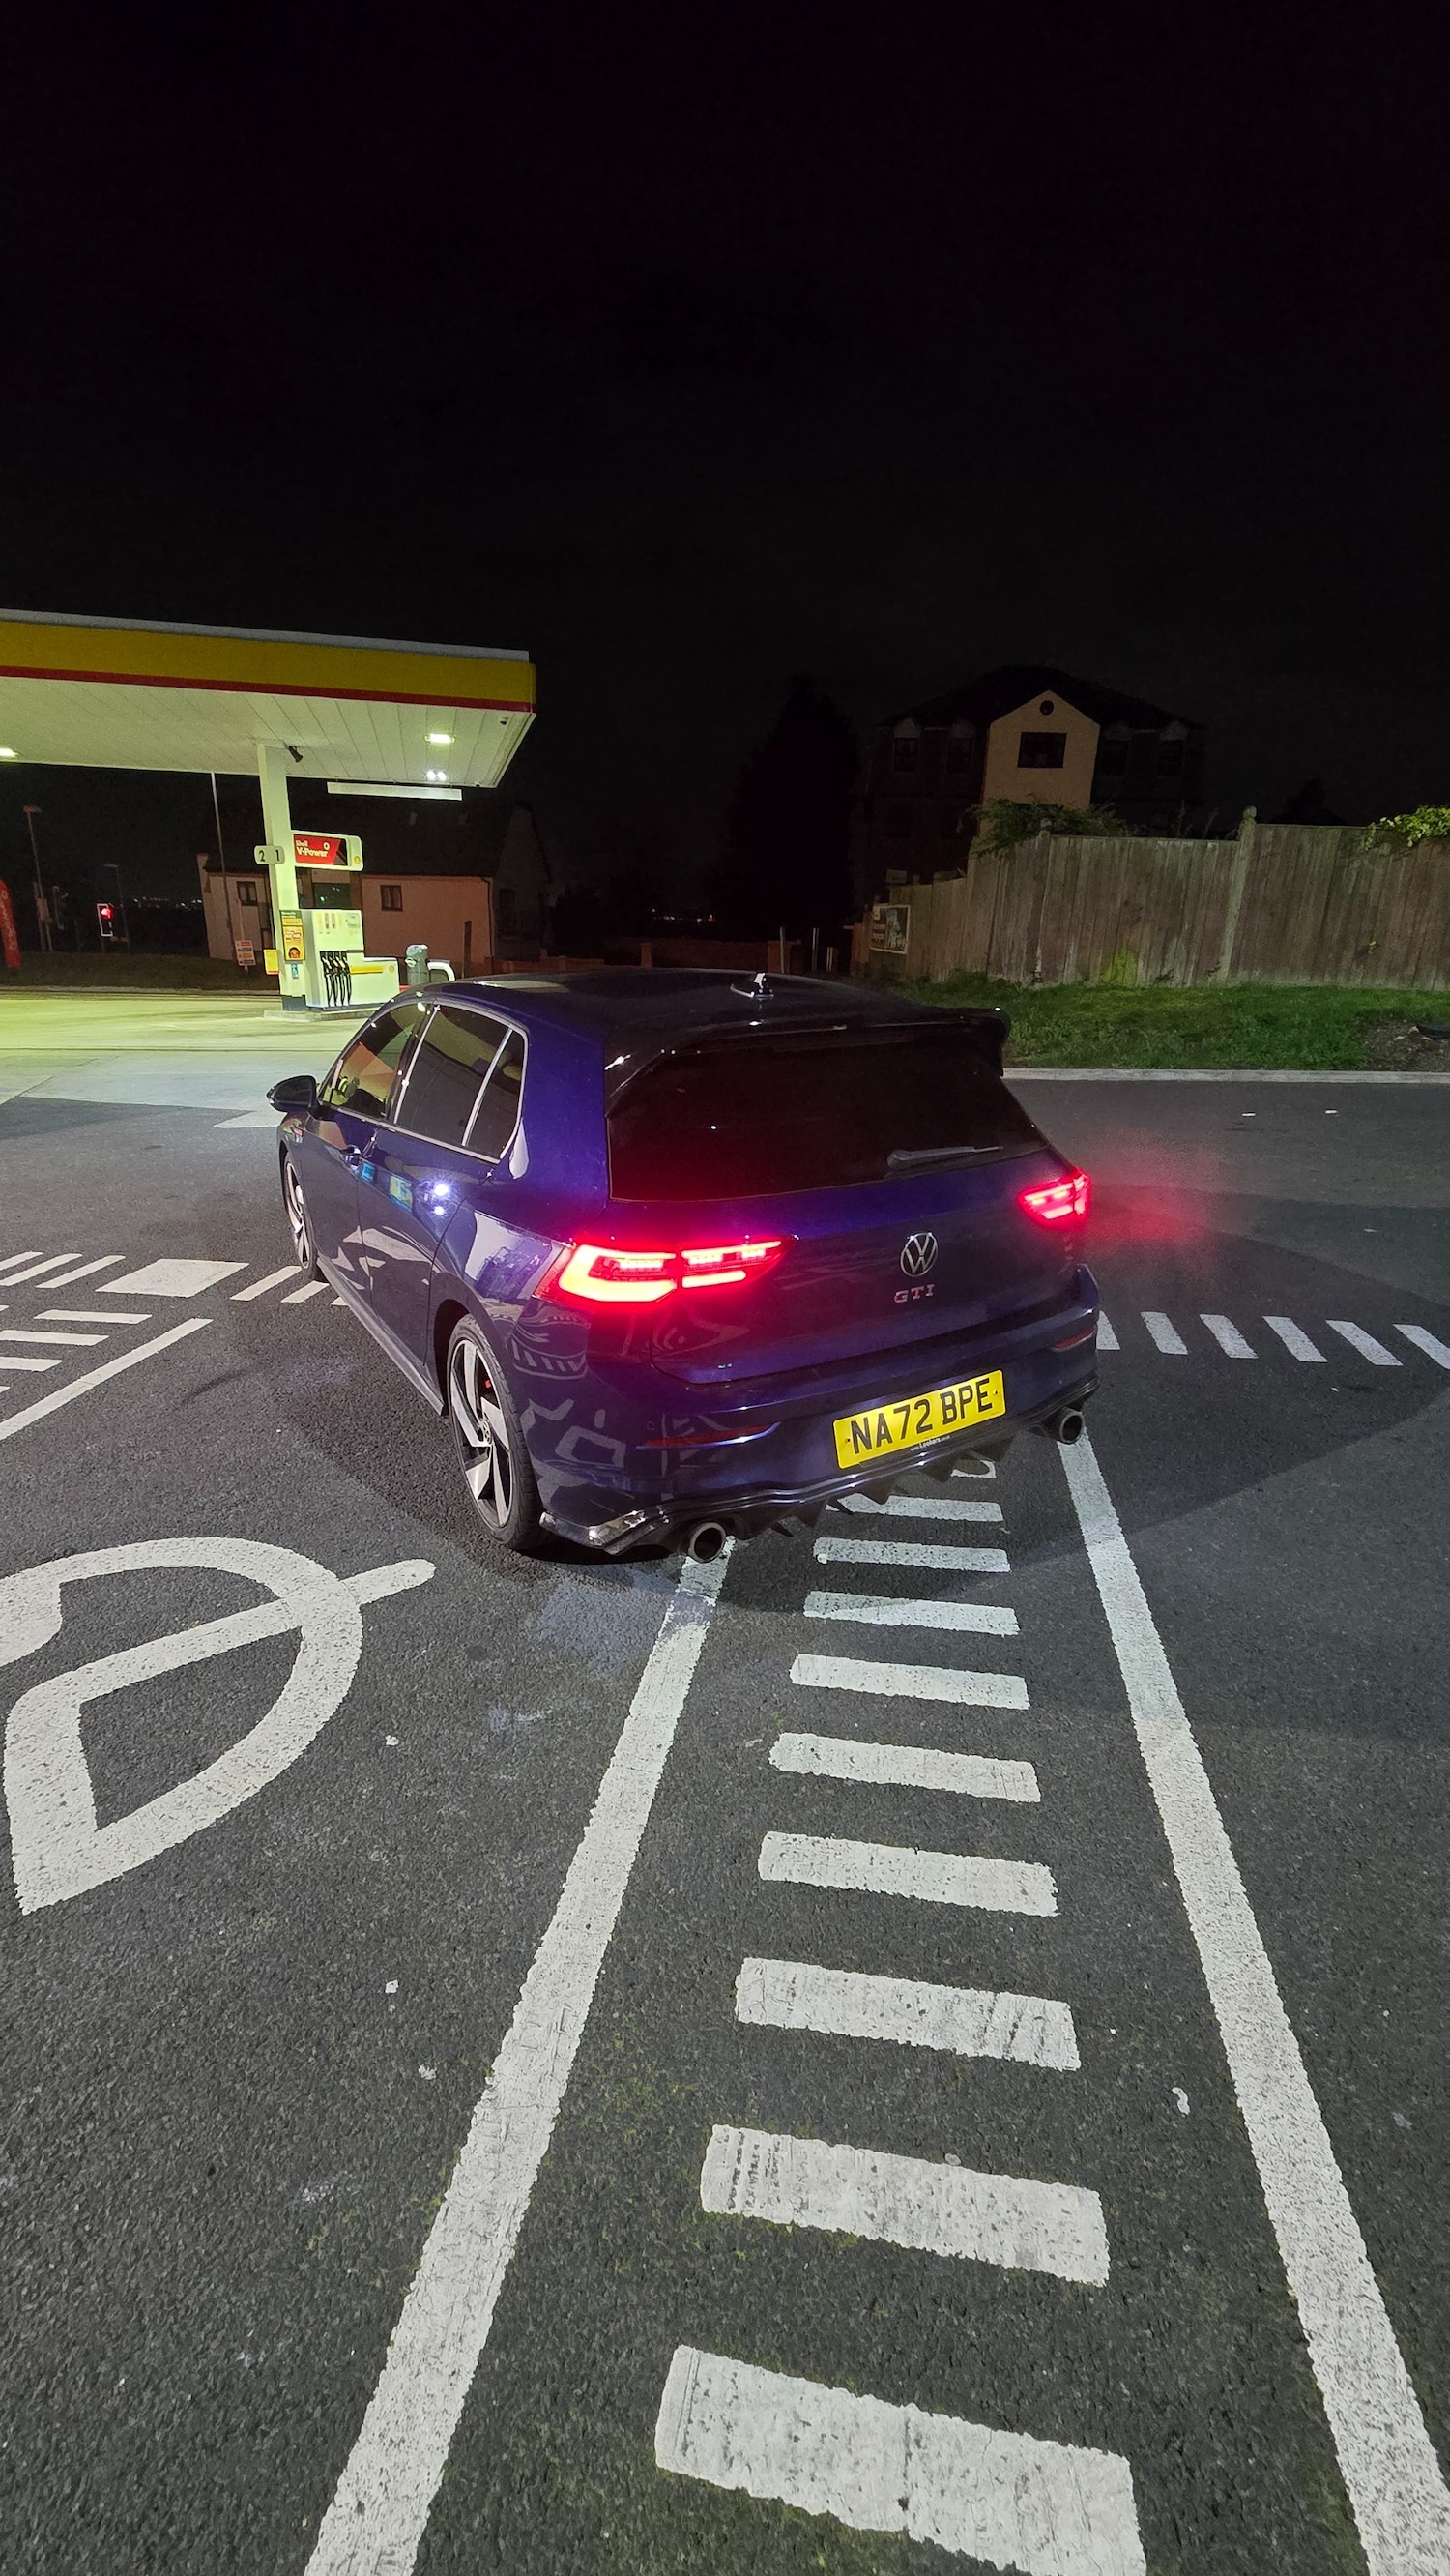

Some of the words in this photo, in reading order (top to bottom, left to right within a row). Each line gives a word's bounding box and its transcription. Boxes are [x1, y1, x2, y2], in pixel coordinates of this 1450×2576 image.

[258, 849, 266, 863] 2
[276, 849, 280, 862] 1
[296, 846, 328, 857] V-Power
[893, 1283, 935, 1303] GTI
[850, 1398, 933, 1455] NA72
[940, 1377, 993, 1426] BPE
